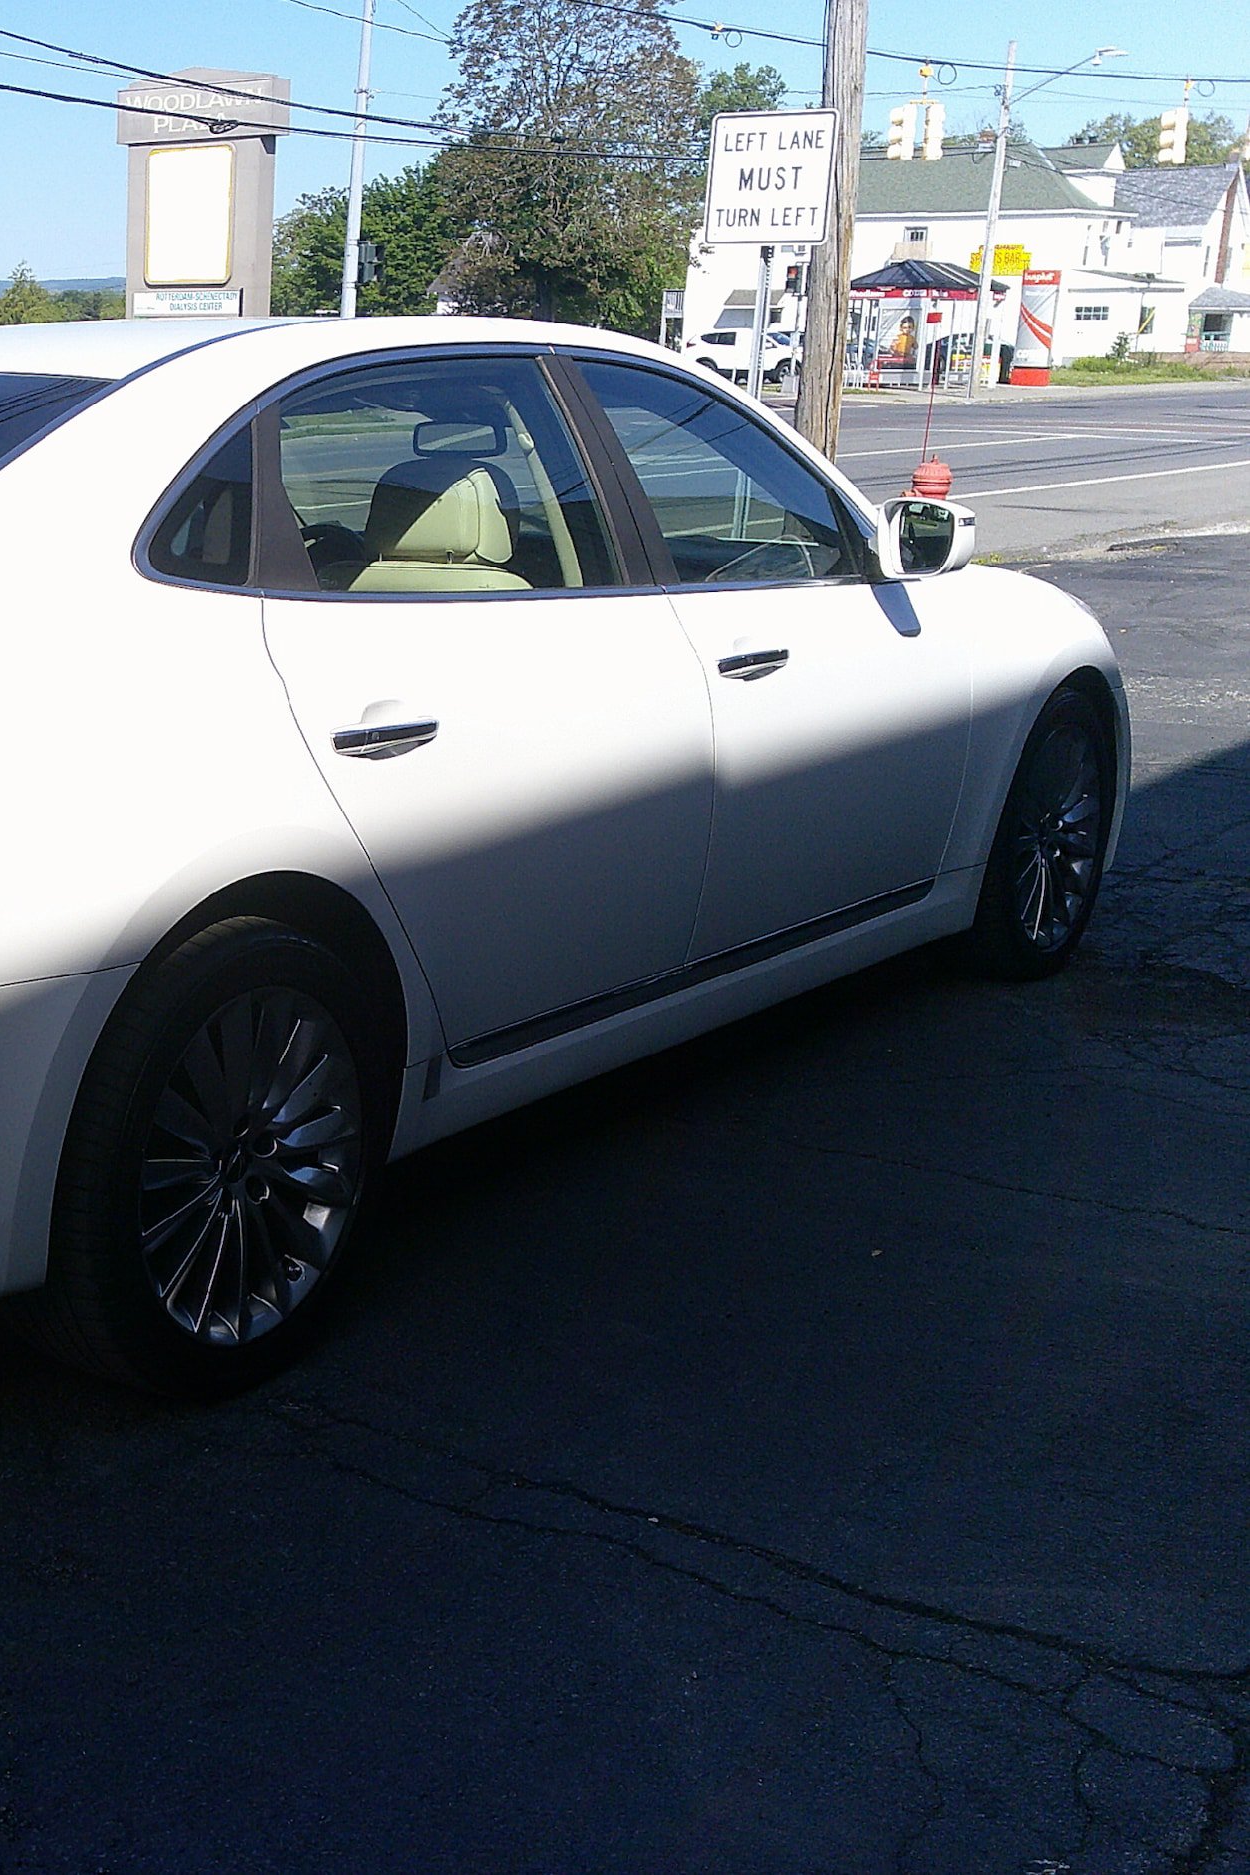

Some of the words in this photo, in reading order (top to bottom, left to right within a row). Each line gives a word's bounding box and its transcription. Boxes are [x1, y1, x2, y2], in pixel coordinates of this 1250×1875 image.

[126, 87, 262, 113] WOODLAWN
[724, 132, 767, 152] LEFT
[778, 130, 825, 150] LANE
[739, 166, 802, 191] MUST
[716, 208, 760, 227] TURN
[770, 207, 818, 226] LEFT
[199, 302, 223, 311] CENTER
